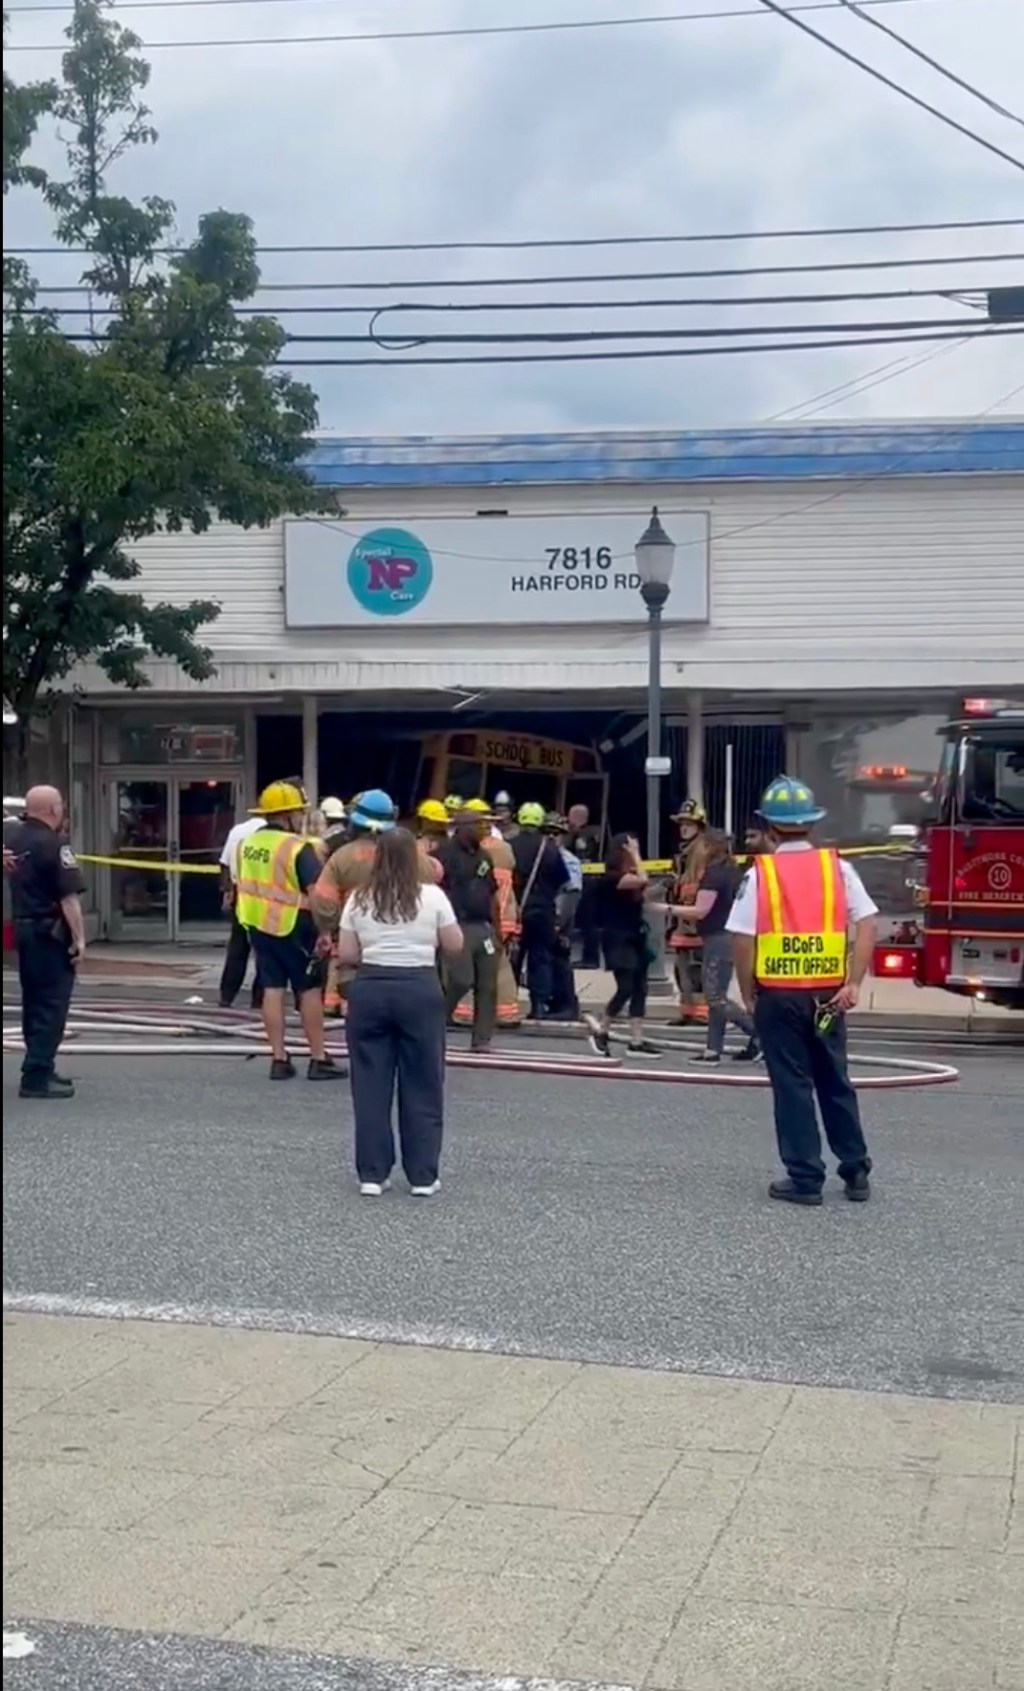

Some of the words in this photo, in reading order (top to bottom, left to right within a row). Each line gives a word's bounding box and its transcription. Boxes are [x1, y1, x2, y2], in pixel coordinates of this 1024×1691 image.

[544, 546, 612, 571] 7816
[367, 557, 418, 591] NP
[511, 574, 608, 592] HARFORD
[539, 747, 564, 768] BUS
[994, 869, 1008, 883] 10
[782, 936, 824, 954] BCoFD
[765, 956, 800, 975] SAFETY
[803, 957, 839, 975] OFFICER
